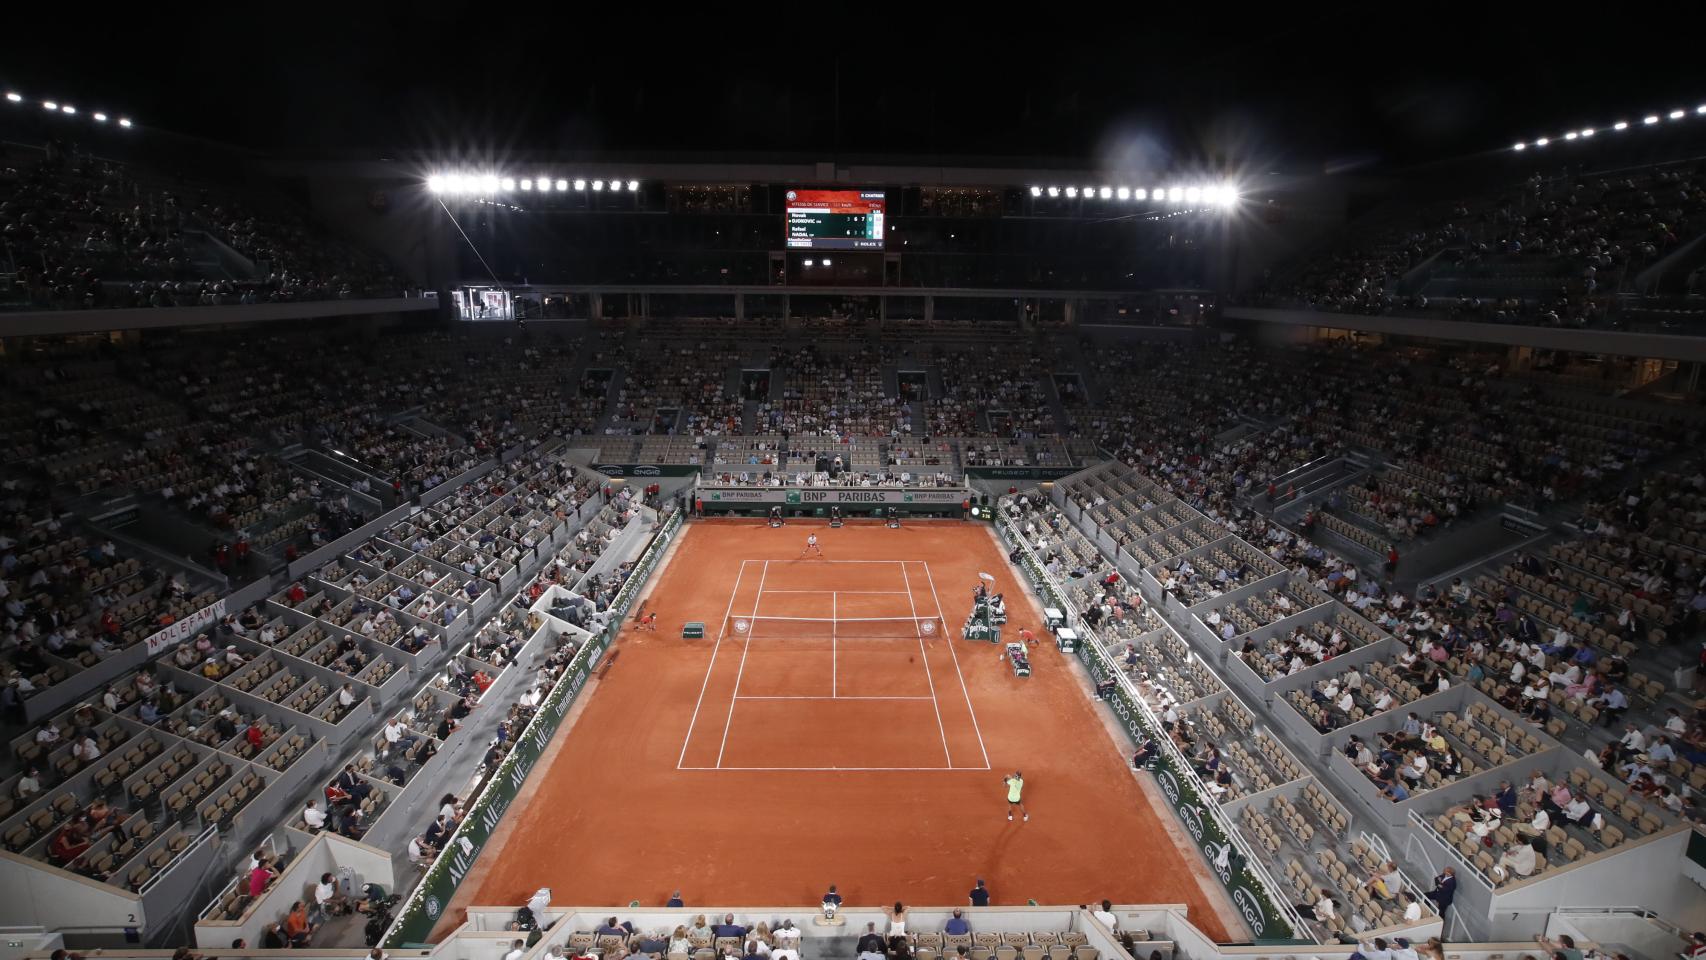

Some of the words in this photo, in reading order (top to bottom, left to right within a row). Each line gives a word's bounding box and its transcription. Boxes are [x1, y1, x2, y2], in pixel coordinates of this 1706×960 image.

[804, 492, 826, 501] BNP
[838, 492, 885, 502] PARIBAS
[1111, 693, 1129, 720] oppo
[128, 914, 136, 922] 2
[1512, 912, 1519, 920] 7
